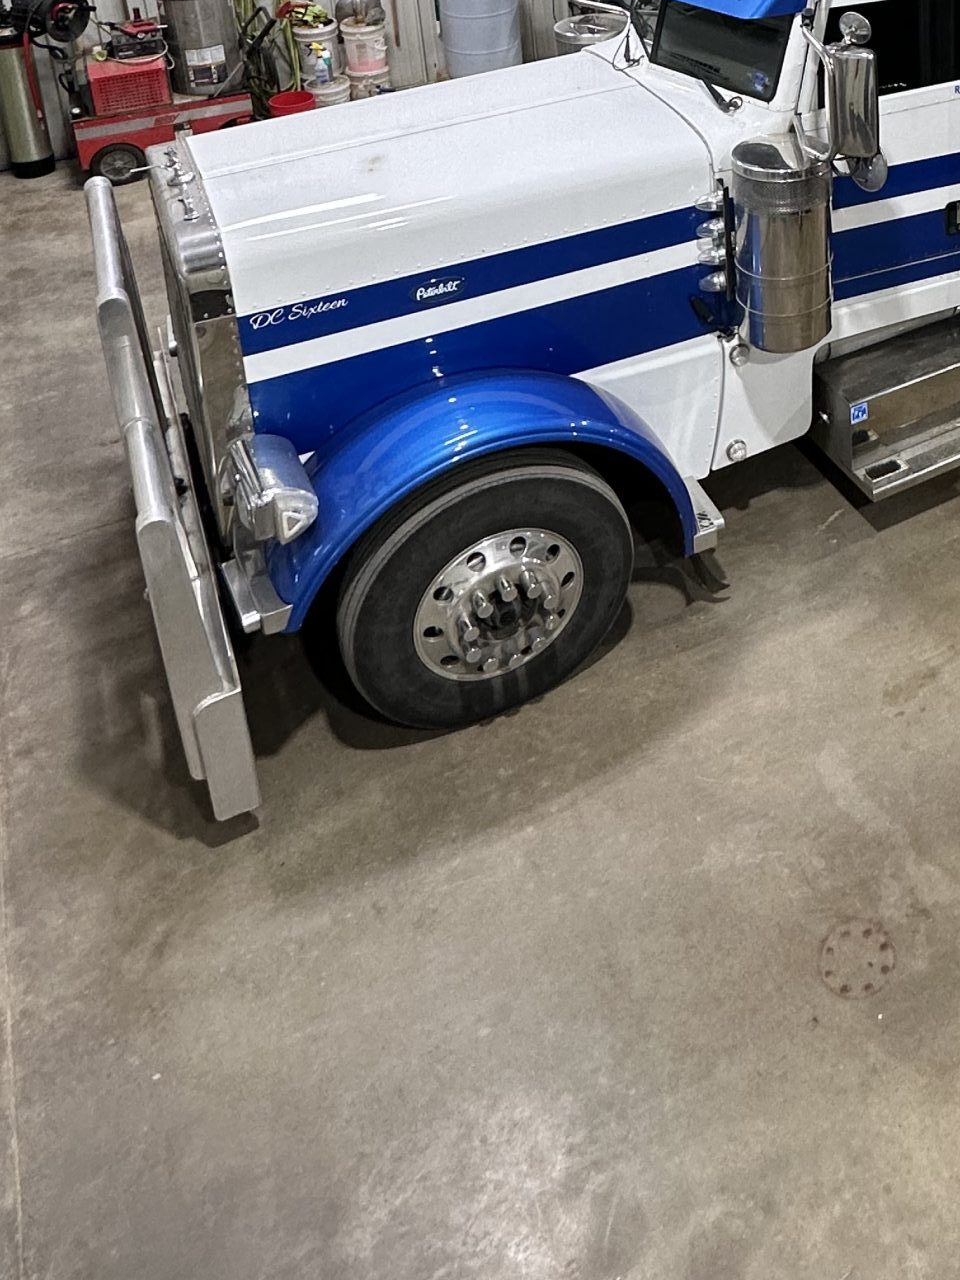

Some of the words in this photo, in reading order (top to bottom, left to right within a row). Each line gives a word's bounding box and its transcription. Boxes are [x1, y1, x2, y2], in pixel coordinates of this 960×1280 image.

[416, 279, 460, 301] Peterbilt
[250, 308, 285, 330] DC
[288, 298, 349, 320] Sixteen
